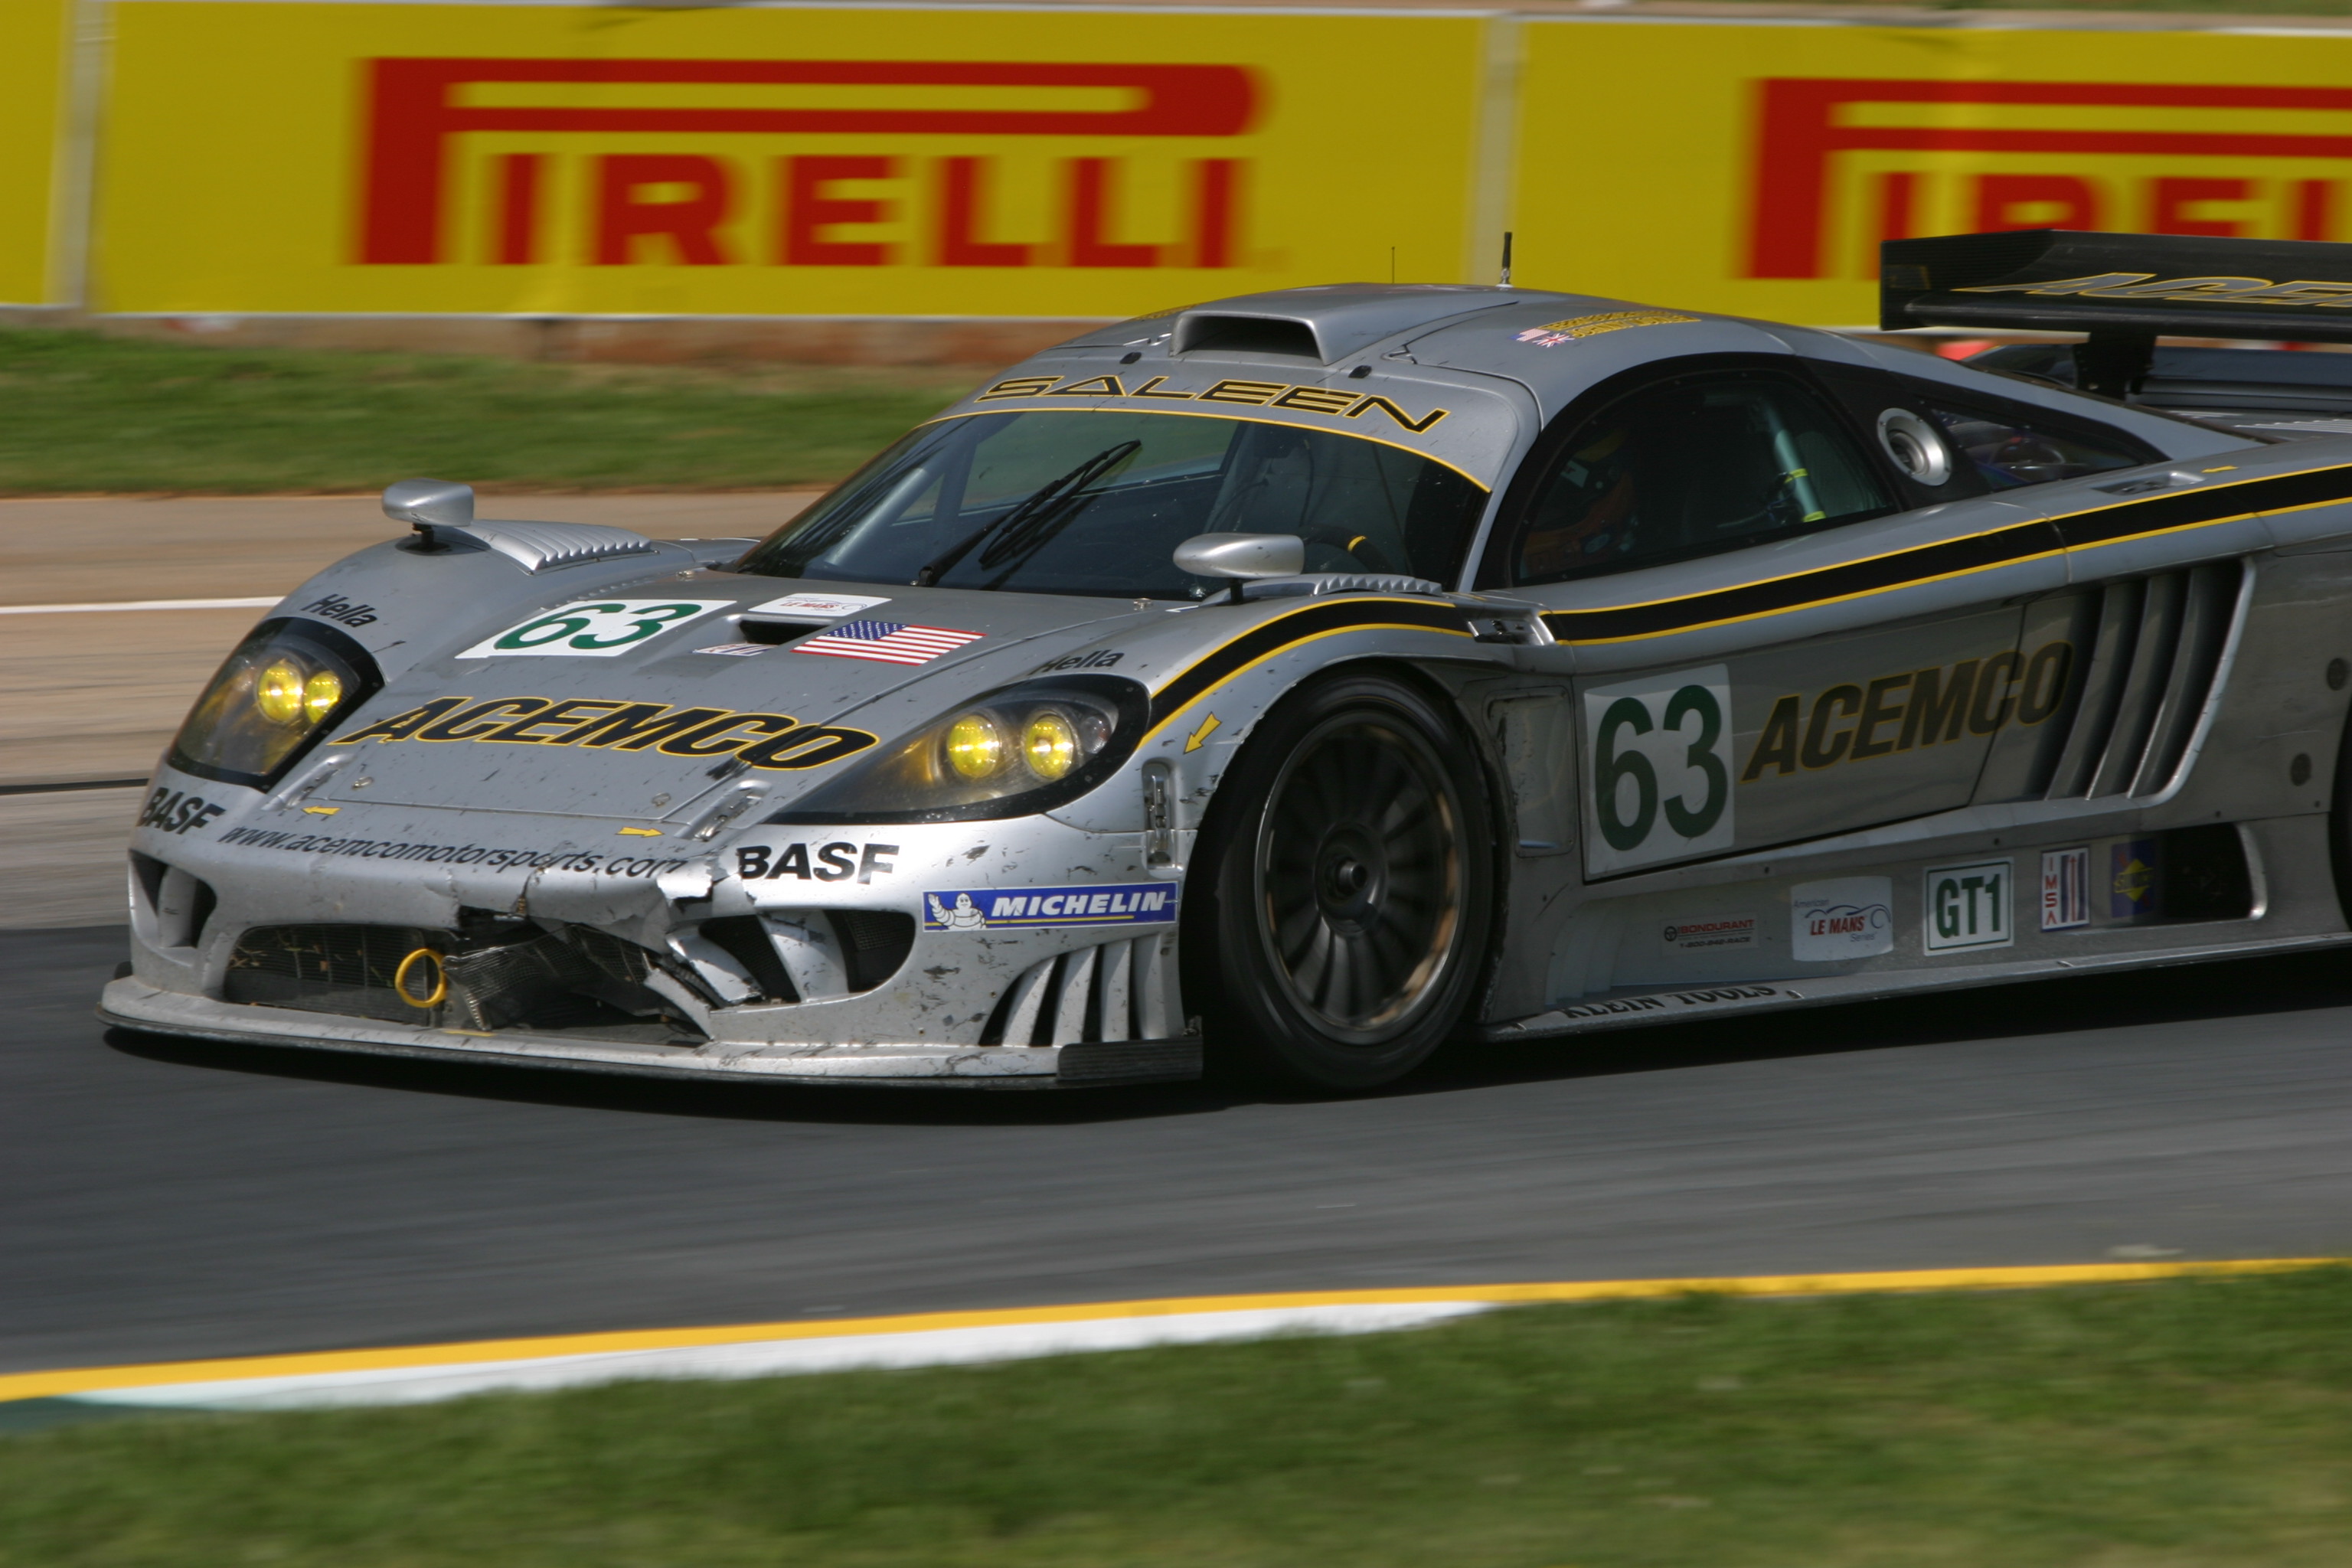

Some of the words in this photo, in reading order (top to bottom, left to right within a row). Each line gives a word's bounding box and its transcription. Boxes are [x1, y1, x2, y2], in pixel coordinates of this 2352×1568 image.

[352, 57, 1271, 268] PIRELLI
[1950, 272, 2352, 307] ACE
[974, 374, 1452, 434] SALEEN
[300, 594, 379, 629] Hella
[493, 602, 704, 651] 63
[1027, 649, 1125, 675] Hella
[325, 696, 880, 771] ACEMCO
[1740, 640, 2074, 784] ACEMCO
[1593, 684, 1729, 851] 63
[136, 787, 227, 835] BASF
[217, 826, 688, 879] www.acemcomotorsports.com
[737, 842, 900, 885] BASF
[991, 890, 1167, 918] MICHELIN
[1680, 920, 1755, 934] BONDURANT
[1810, 920, 1826, 936] LE
[1829, 916, 1866, 935] MANS
[1936, 875, 2002, 940] GT1
[1561, 997, 1665, 1019] KLEIN
[1666, 985, 1777, 1006] TOOLS
